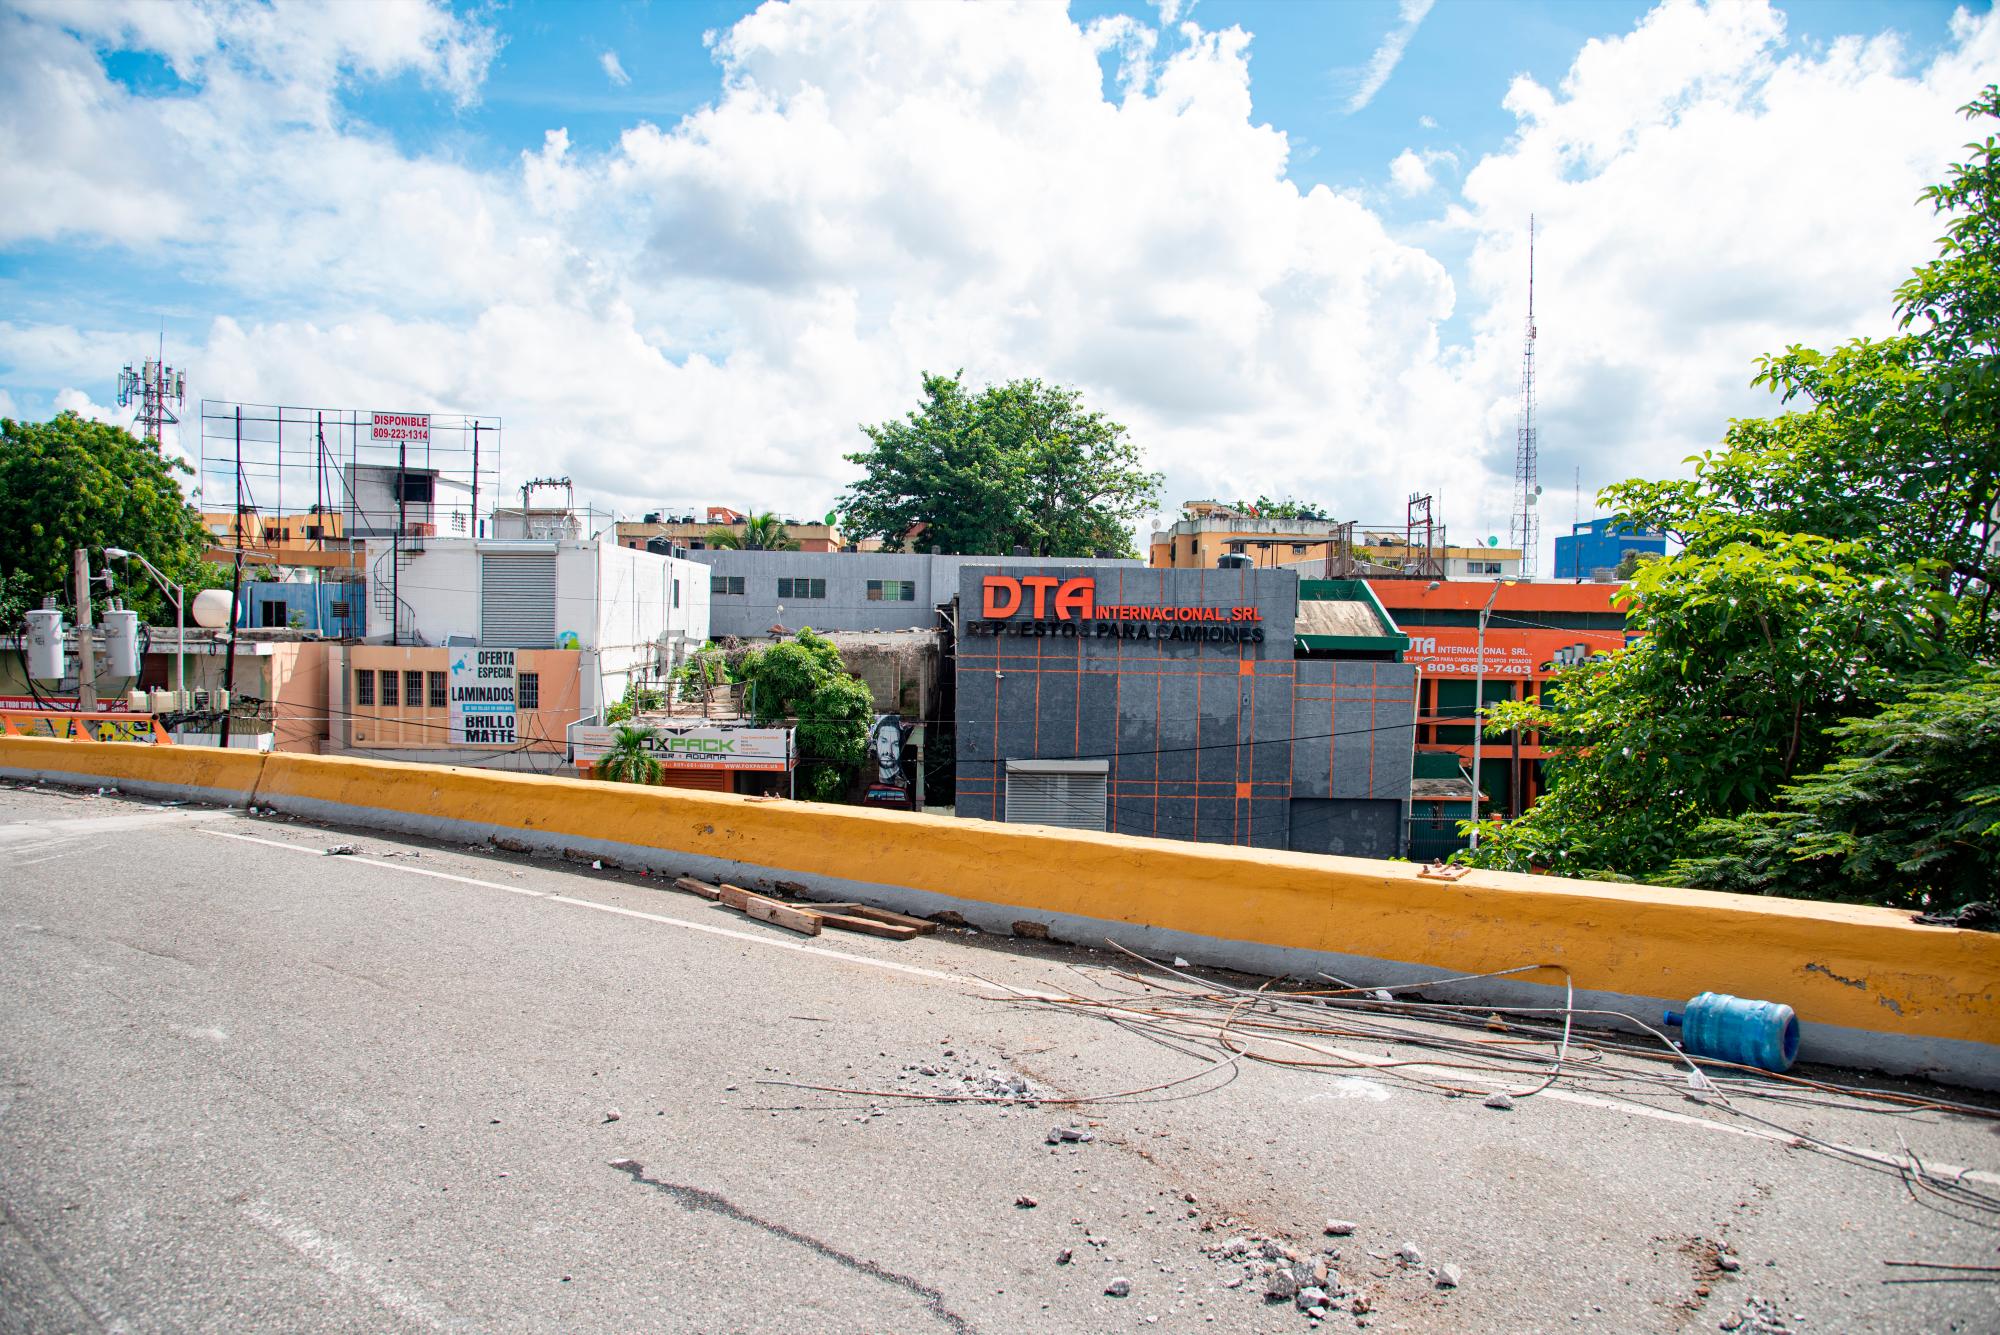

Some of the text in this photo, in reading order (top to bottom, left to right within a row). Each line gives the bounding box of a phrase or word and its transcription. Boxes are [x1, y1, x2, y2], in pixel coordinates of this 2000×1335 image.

[374, 415, 428, 427] DISPONIBLE
[373, 427, 428, 440] 809-223-1314
[982, 575, 1095, 620] DTA
[966, 620, 1265, 644] REPUESTOS PARA CAMIONES
[1438, 646, 1506, 656] INTERNACONAL
[478, 651, 514, 665] OFERTA
[478, 667, 514, 679] ESPECIAL
[451, 687, 514, 701] LAMINADOS
[466, 715, 514, 728] BRILLO
[466, 730, 514, 742] MATTE
